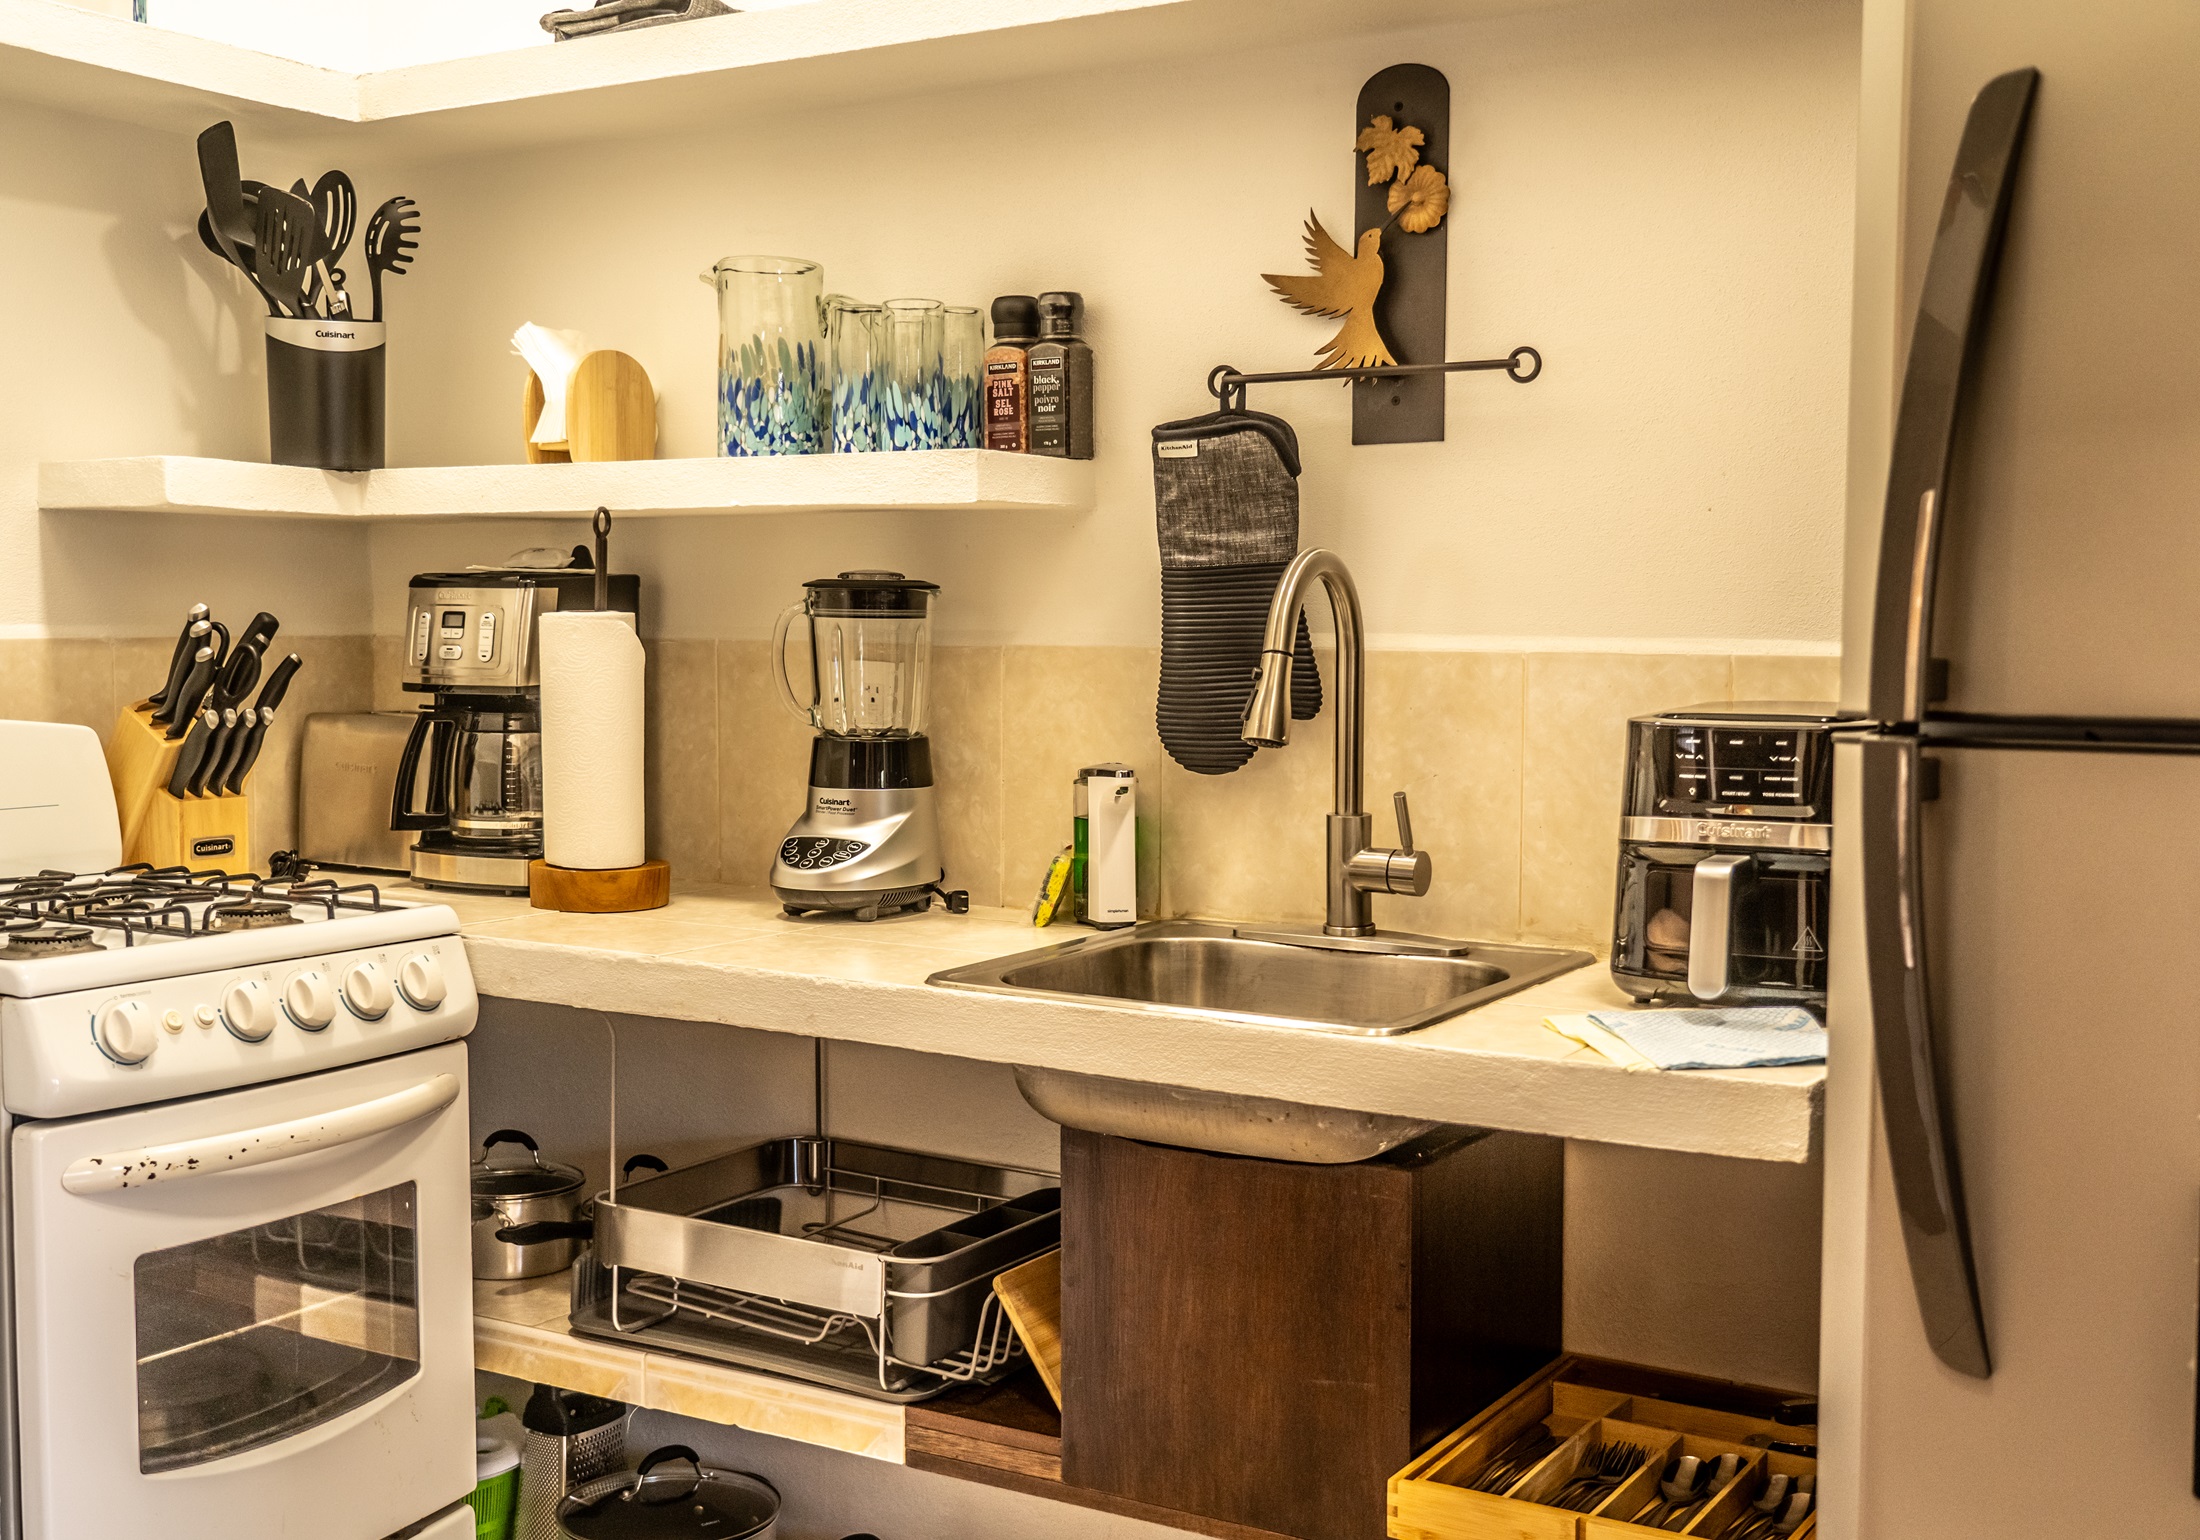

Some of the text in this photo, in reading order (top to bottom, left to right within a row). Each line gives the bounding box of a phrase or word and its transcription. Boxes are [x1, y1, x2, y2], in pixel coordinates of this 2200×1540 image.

[315, 329, 355, 340] Cuisinart
[993, 379, 1013, 389] PINK
[1033, 374, 1059, 384] black
[992, 388, 1014, 397] SALT
[1032, 383, 1061, 394] pepper
[995, 399, 1012, 408] SEL
[1034, 394, 1060, 406] poivre
[993, 407, 1014, 417] ROSE
[1037, 403, 1057, 413] noir
[819, 797, 850, 806] Cuisinart
[1697, 821, 1773, 839] Cuisinart
[195, 843, 229, 852] Cuisinart
